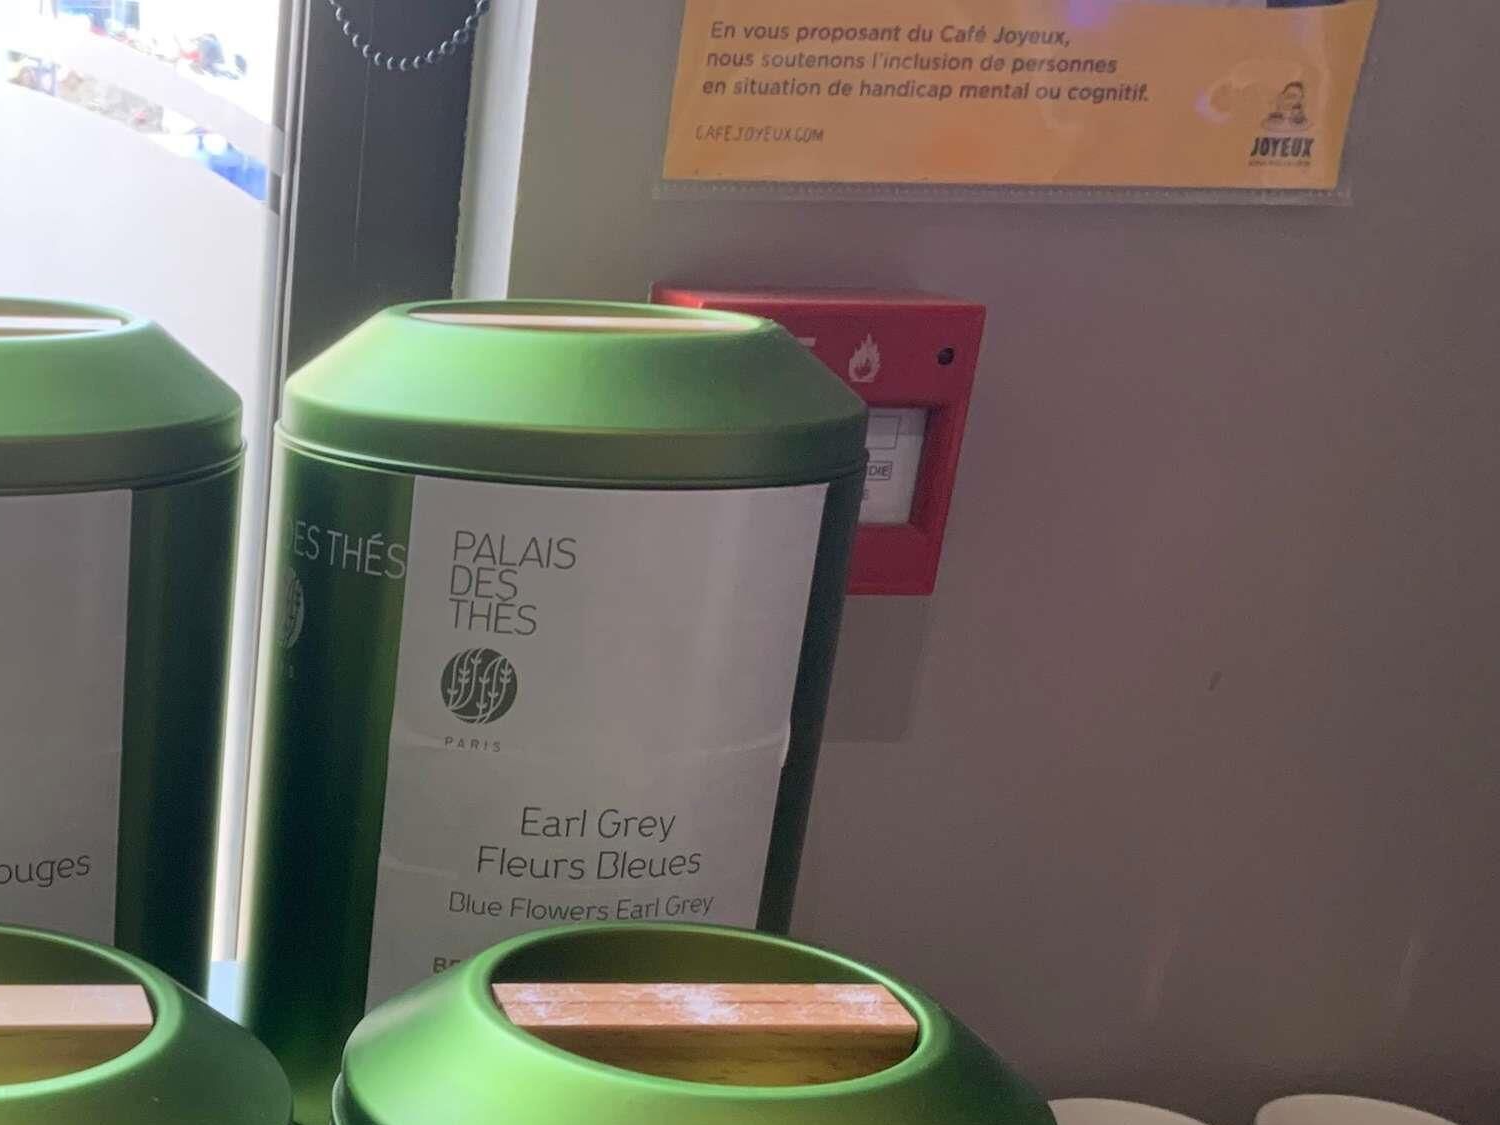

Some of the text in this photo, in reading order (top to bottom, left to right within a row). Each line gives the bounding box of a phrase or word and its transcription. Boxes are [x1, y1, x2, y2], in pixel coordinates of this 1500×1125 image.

[710, 21, 1071, 49] En vous proposant du Café Joyeux,
[706, 51, 1117, 76] nous soutenons l'inclusion de personnes
[702, 77, 1149, 105] en situation de handicap mental ou cognitif.
[1250, 137, 1315, 157] JOYEUX
[327, 532, 406, 579] THÉS
[453, 530, 577, 570] PALAIS
[450, 564, 518, 602] DES
[444, 735, 502, 752] PARIS
[520, 806, 677, 843] Earl Grey
[477, 845, 701, 880] Fleurs Bleues
[449, 891, 714, 921] Blue Flowers Earl Grey
